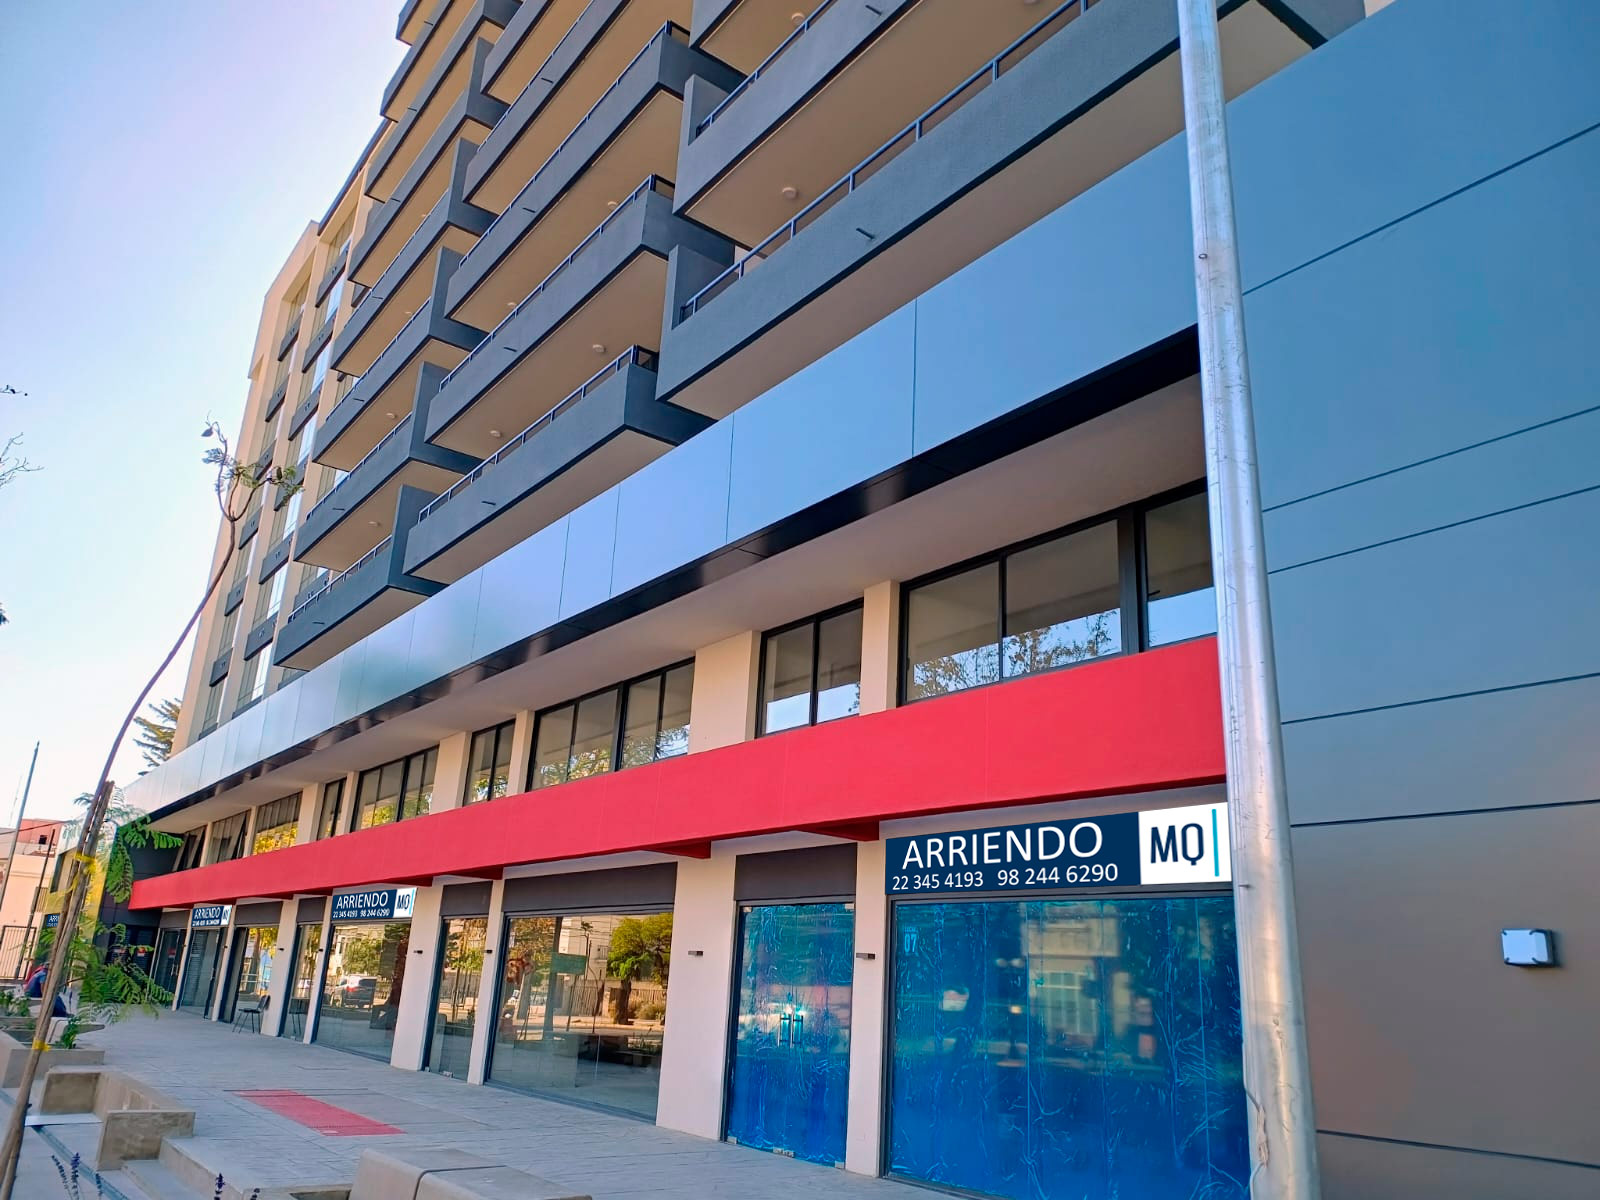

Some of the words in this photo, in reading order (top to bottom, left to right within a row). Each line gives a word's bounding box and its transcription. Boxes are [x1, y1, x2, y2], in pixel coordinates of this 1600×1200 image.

[902, 822, 1103, 870] ARRIENDO
[1150, 823, 1204, 866] MQ
[892, 876, 909, 890] 22
[913, 874, 940, 890] 345
[944, 871, 984, 888] 4193
[997, 869, 1020, 886] 98
[1025, 867, 1060, 885] 244
[1066, 863, 1118, 883] 6290
[336, 891, 389, 909] ARRIENDO
[904, 933, 917, 953] 07
